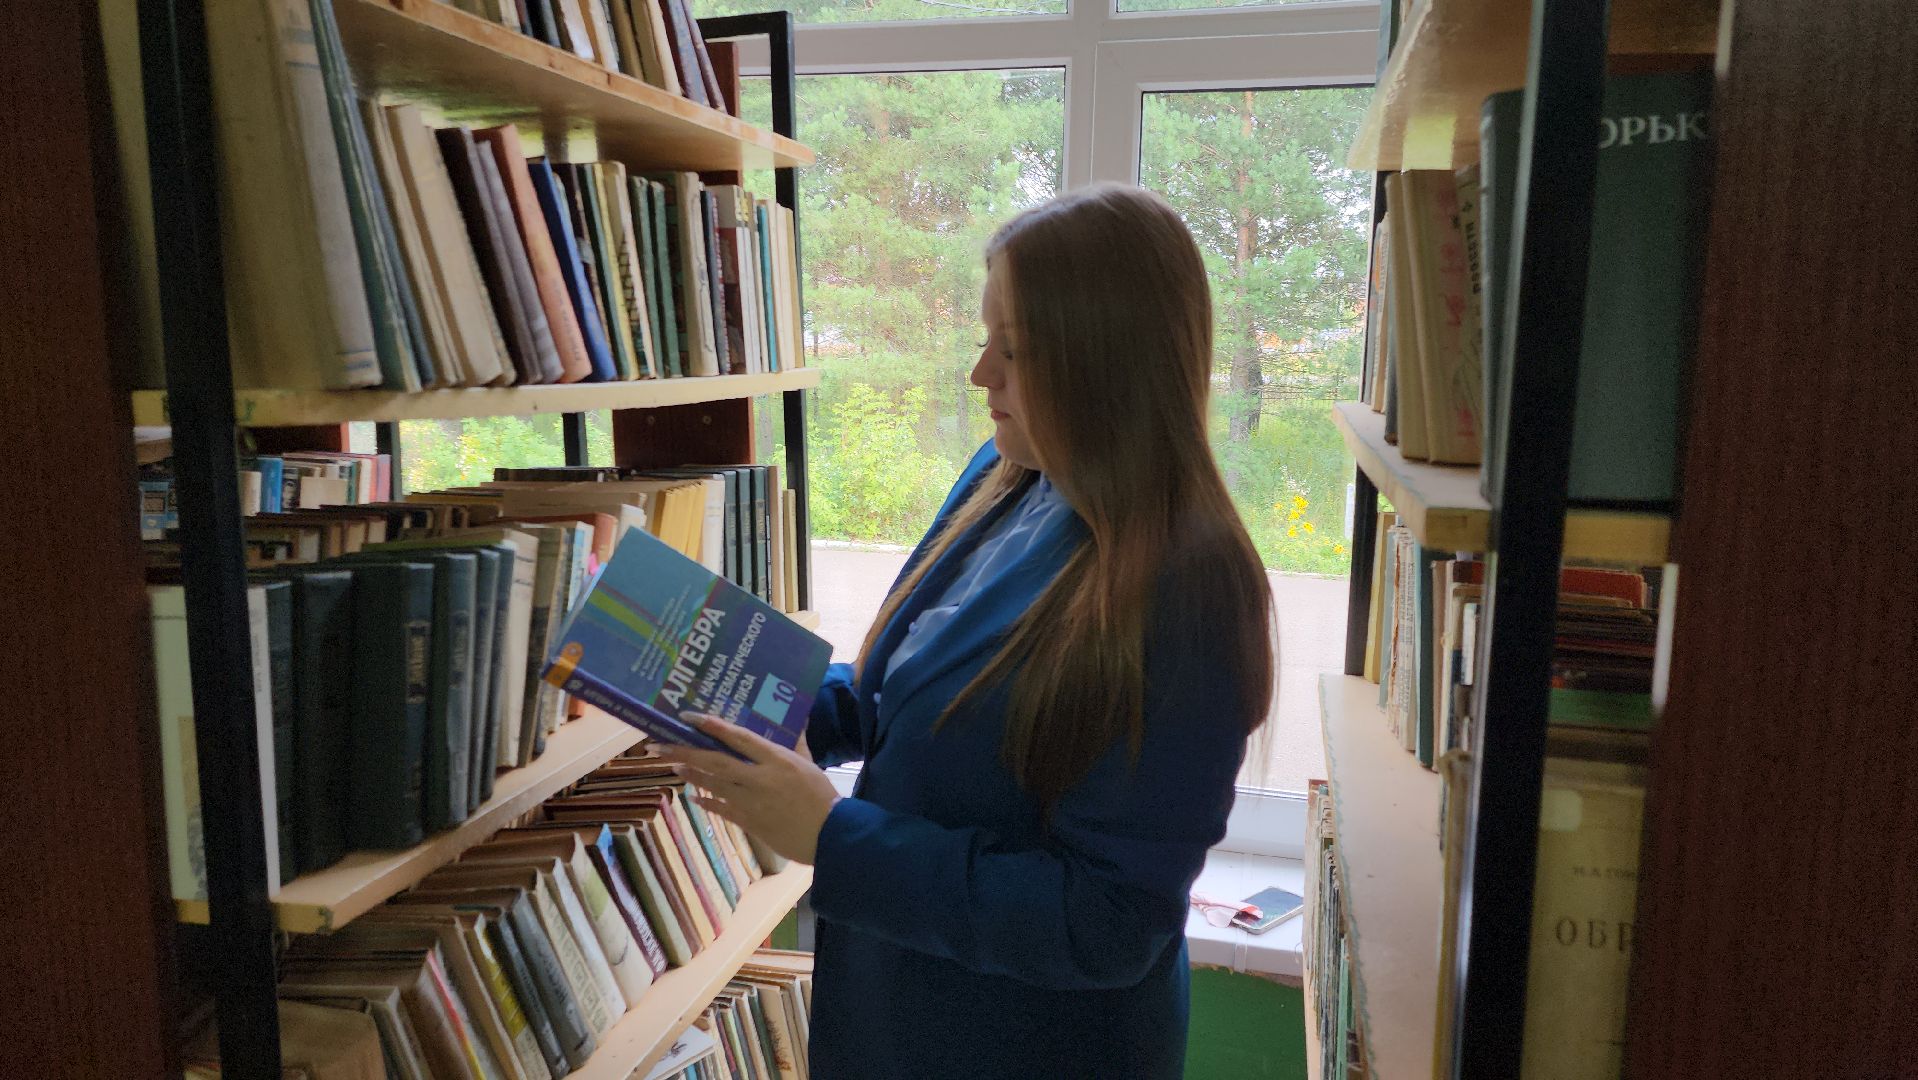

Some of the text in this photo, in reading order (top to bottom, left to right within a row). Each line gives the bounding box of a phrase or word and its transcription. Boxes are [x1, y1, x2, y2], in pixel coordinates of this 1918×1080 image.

[660, 607, 726, 709] АЛГЕБРА
[692, 653, 729, 710] И НАЧАЛА
[708, 612, 767, 715] МАТЕМАТИЧЕСКОГО
[772, 680, 797, 705] 10
